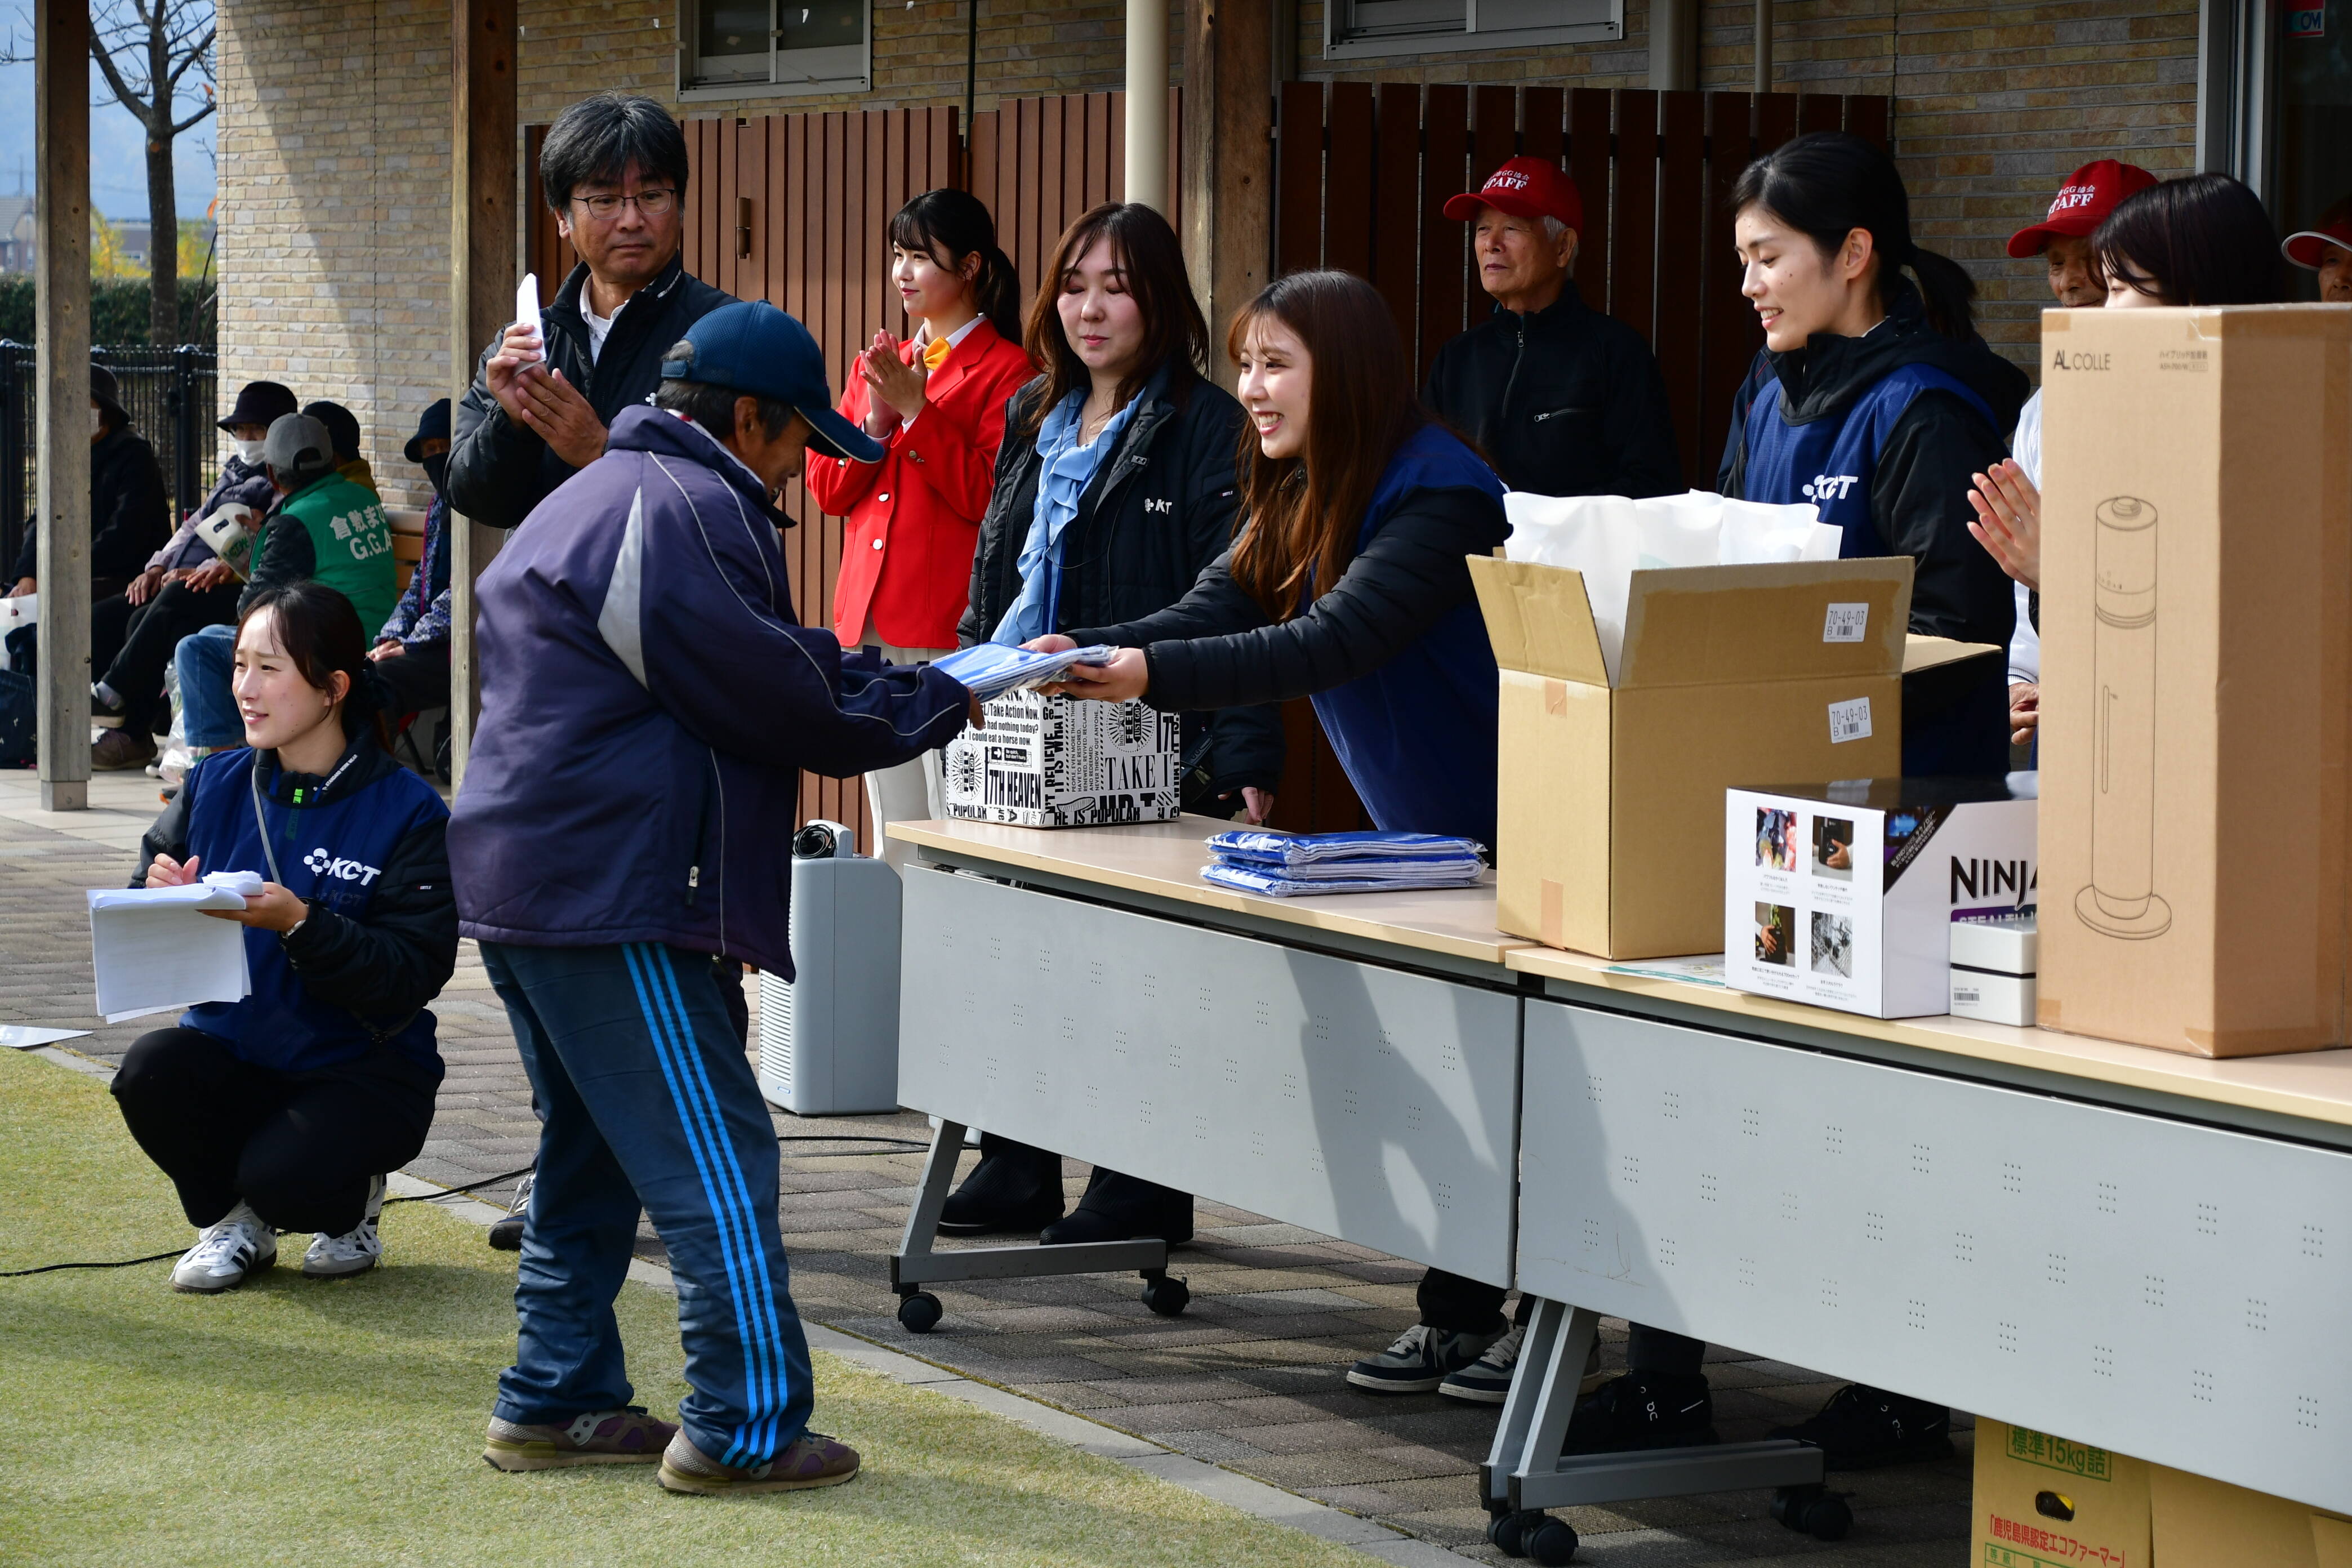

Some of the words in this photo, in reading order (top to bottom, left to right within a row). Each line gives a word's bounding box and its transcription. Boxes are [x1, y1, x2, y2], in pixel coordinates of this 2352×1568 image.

[2288, 11, 2322, 32] COM
[1829, 611, 1865, 625] 70-49-03
[1827, 626, 1833, 635] B
[1005, 705, 1024, 719] Action
[1025, 706, 1040, 720] Now.
[1832, 706, 1868, 725] 70-49-03
[987, 720, 997, 729] had
[999, 723, 1019, 733] nothing
[1021, 724, 1039, 734] today?
[1833, 727, 1839, 736] B
[969, 731, 971, 741] I
[972, 732, 987, 742] could
[988, 734, 997, 743] eat
[1003, 735, 1018, 745] horse
[1104, 755, 1155, 790] TAKE
[989, 769, 1005, 805] 7TH
[1007, 771, 1041, 809] HEAVEN
[327, 857, 381, 886] KCT
